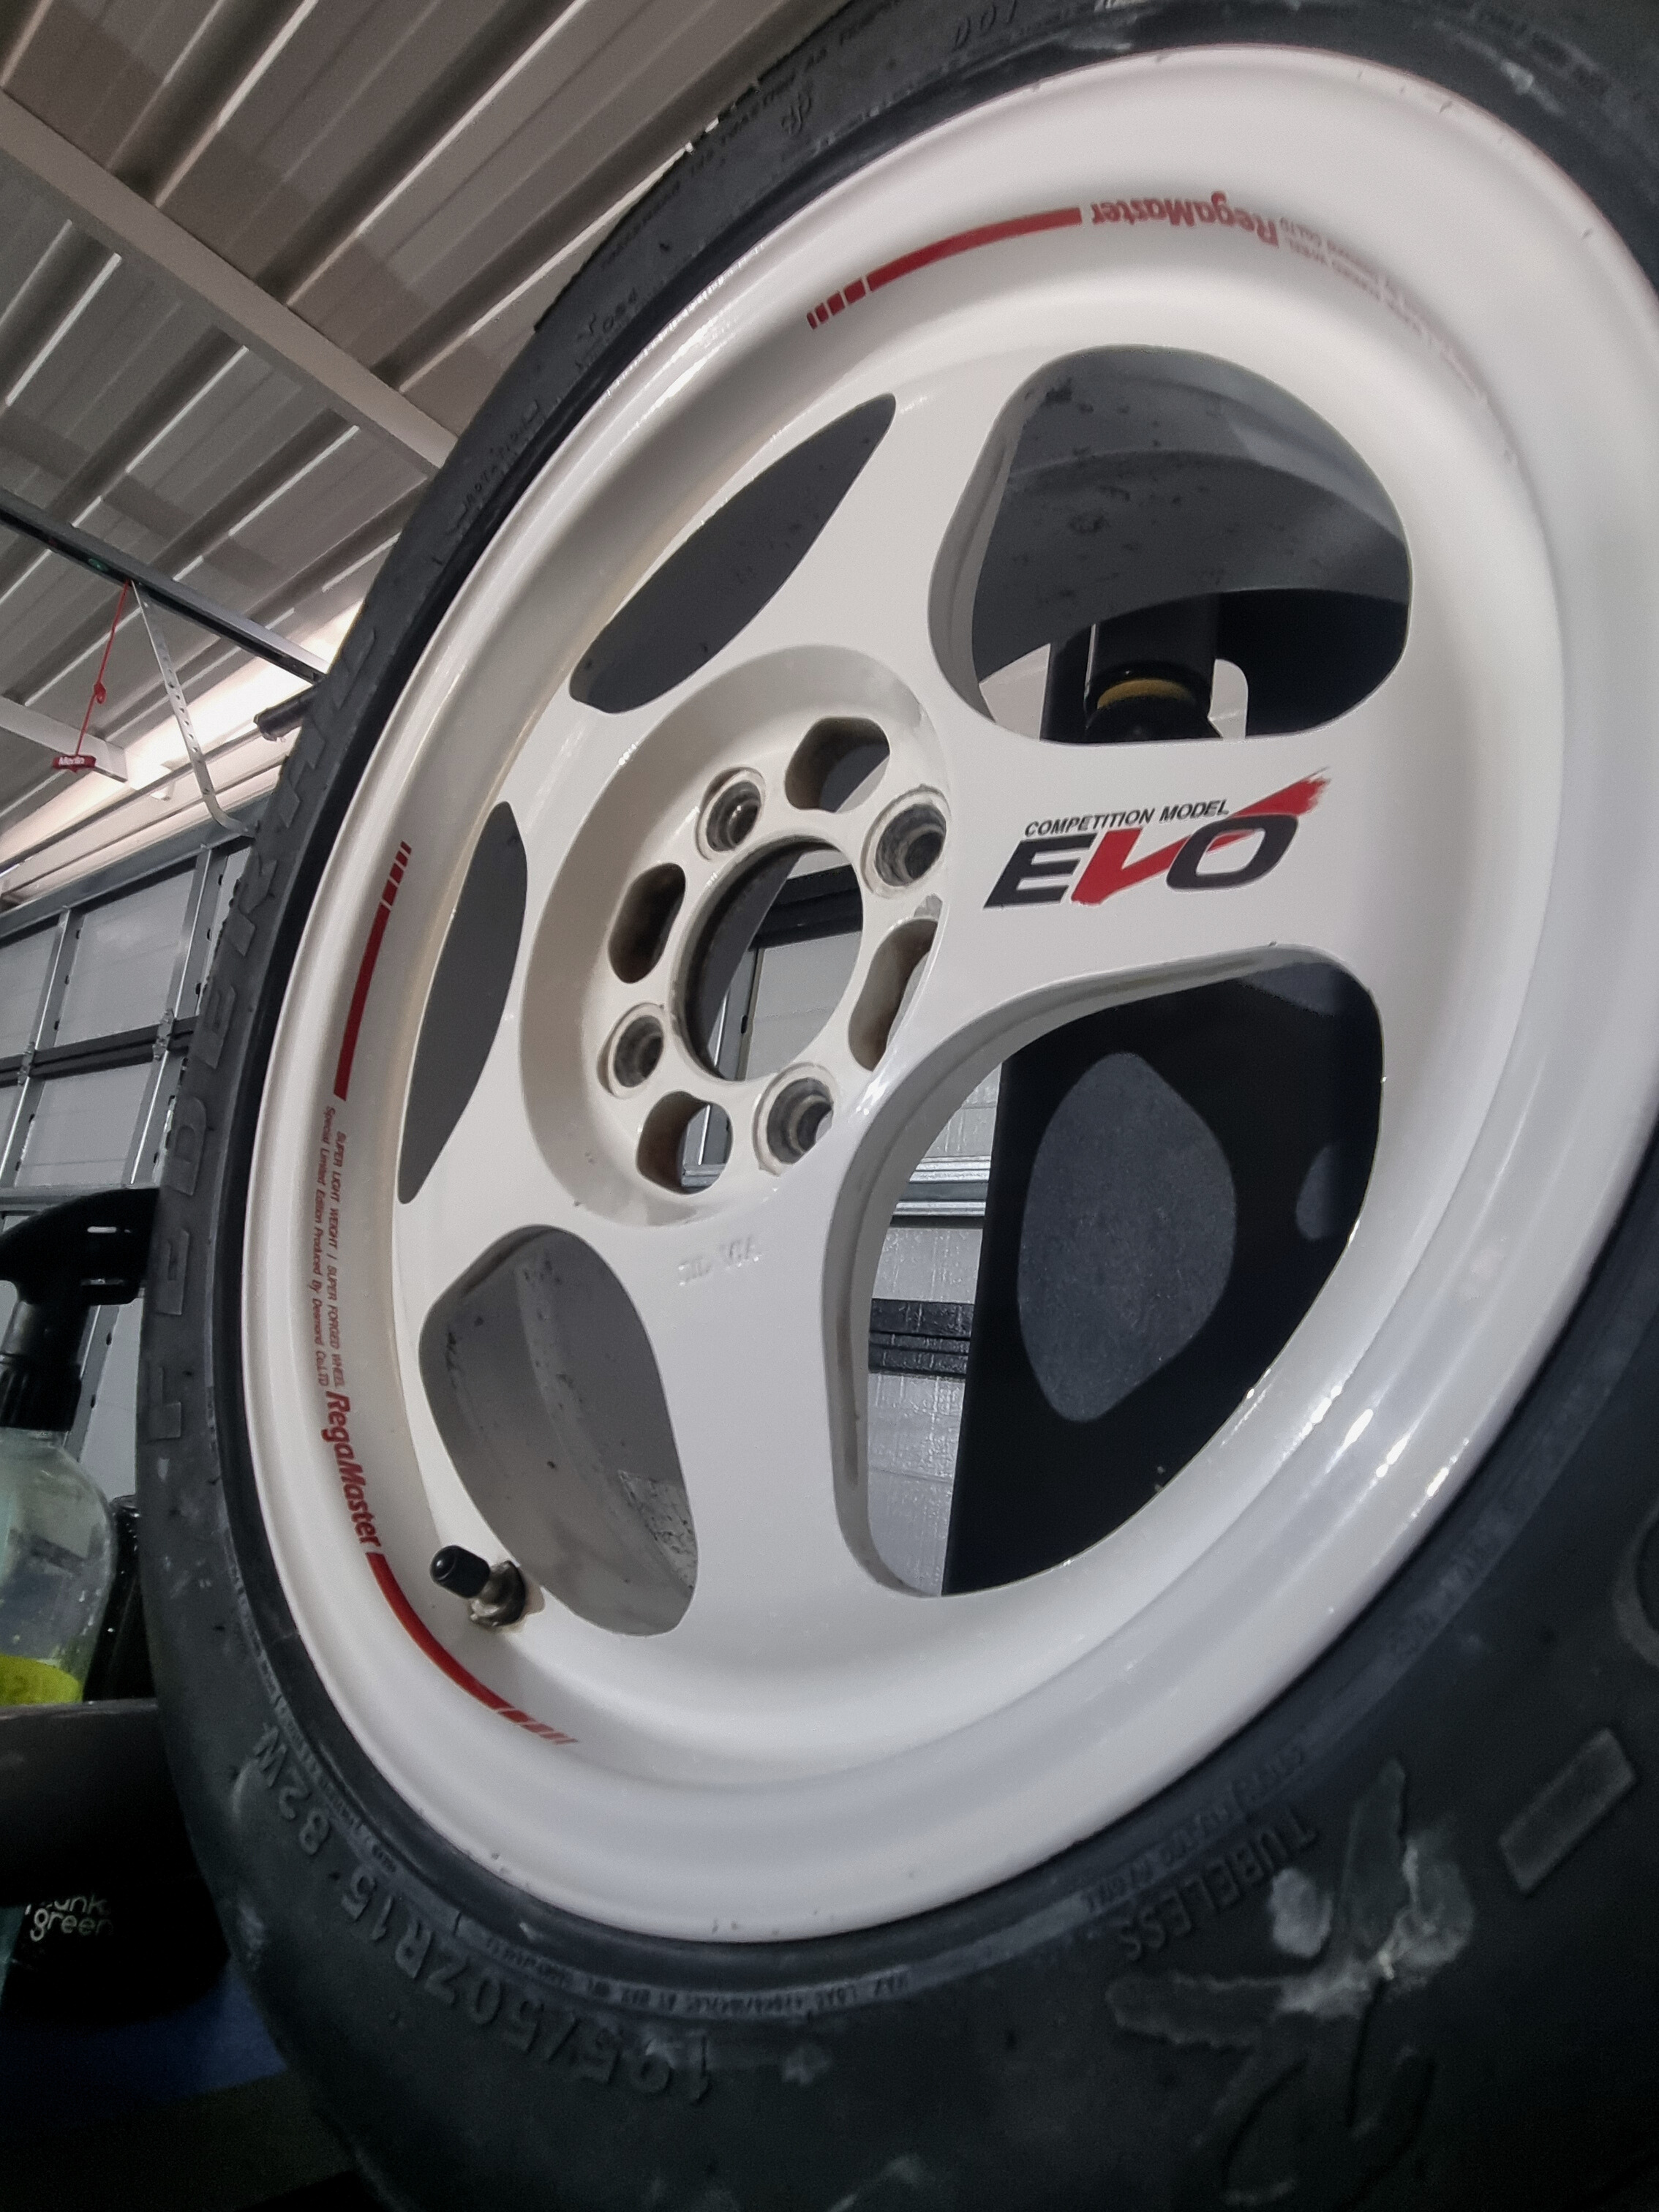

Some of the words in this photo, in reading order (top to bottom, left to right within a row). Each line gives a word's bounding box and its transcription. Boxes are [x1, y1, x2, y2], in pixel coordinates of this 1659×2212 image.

[1091, 190, 1279, 247] RegaMaster
[983, 766, 1331, 909] EVO
[1024, 808, 1155, 838] COMPETITION
[1159, 799, 1229, 822] MODEL
[332, 1131, 347, 1167] SUPER
[315, 1189, 327, 1224] Edition
[331, 1172, 342, 1203] LIGHT
[328, 1208, 339, 1249] WEIGHT
[311, 1227, 324, 1276] Produced
[308, 1279, 322, 1293] By
[326, 1265, 338, 1301] SUPER
[328, 1304, 340, 1350] FORGED
[320, 1390, 382, 1547] RegaMaster
[1119, 1808, 1317, 1962] TUBELESS
[29, 1907, 114, 1942] green
